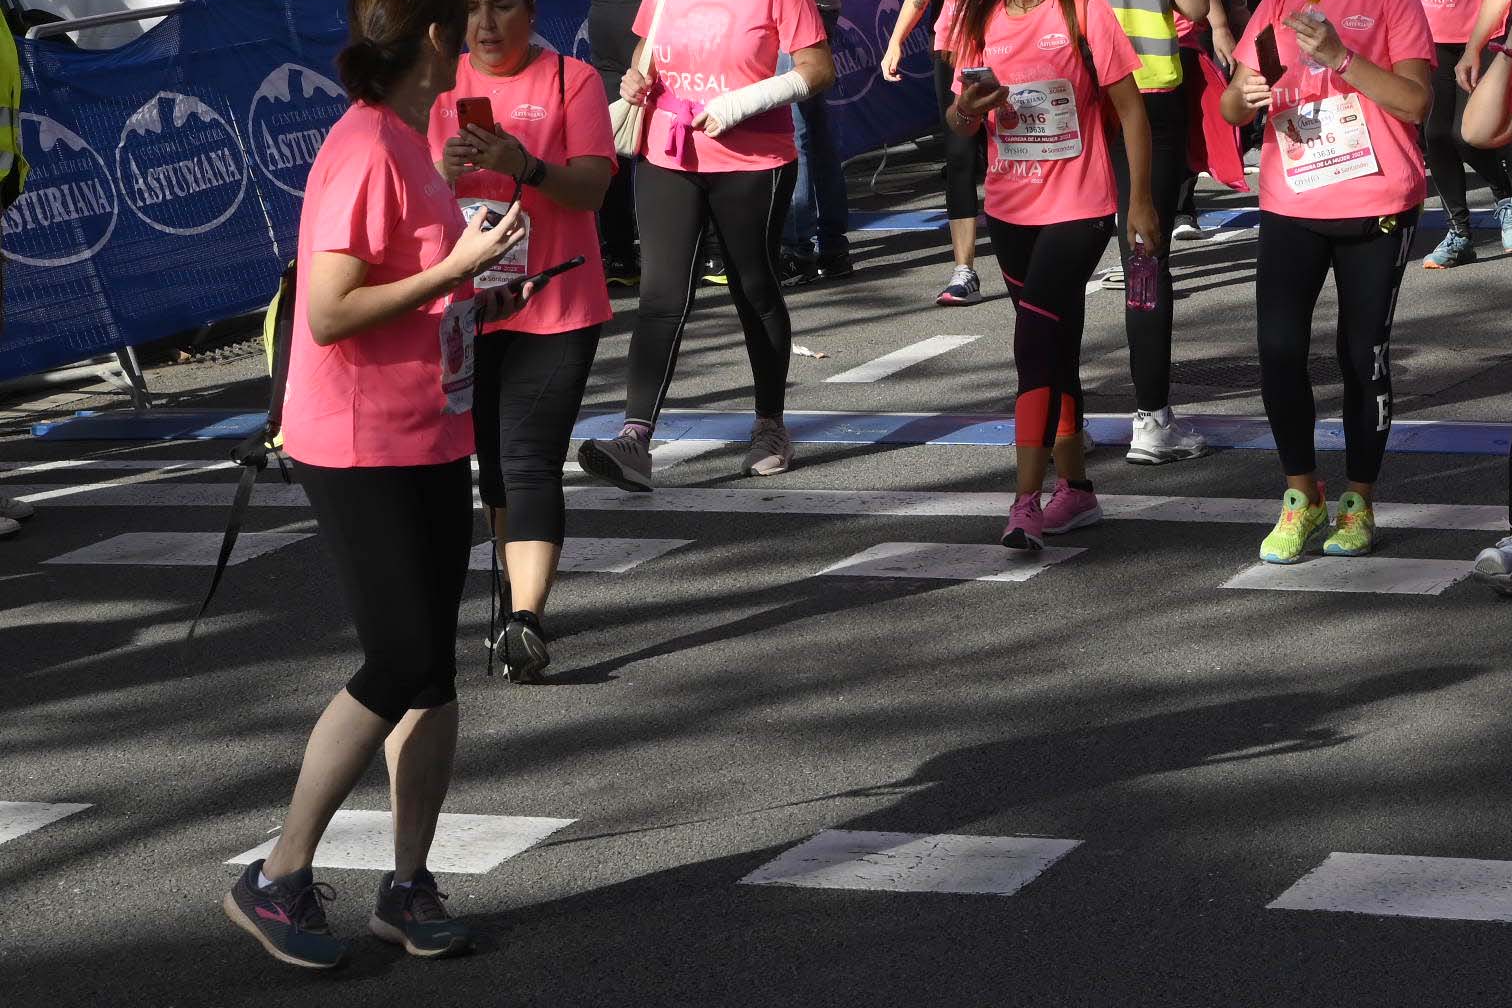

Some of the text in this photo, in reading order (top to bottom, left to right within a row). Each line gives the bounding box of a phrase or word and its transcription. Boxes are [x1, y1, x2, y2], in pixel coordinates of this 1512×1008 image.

[1274, 88, 1299, 107] TU
[1021, 112, 1047, 123] 016
[1025, 126, 1046, 134] 13638
[1306, 132, 1336, 149] 016
[1047, 144, 1076, 155] Santander
[129, 146, 242, 209] ASTURIANA
